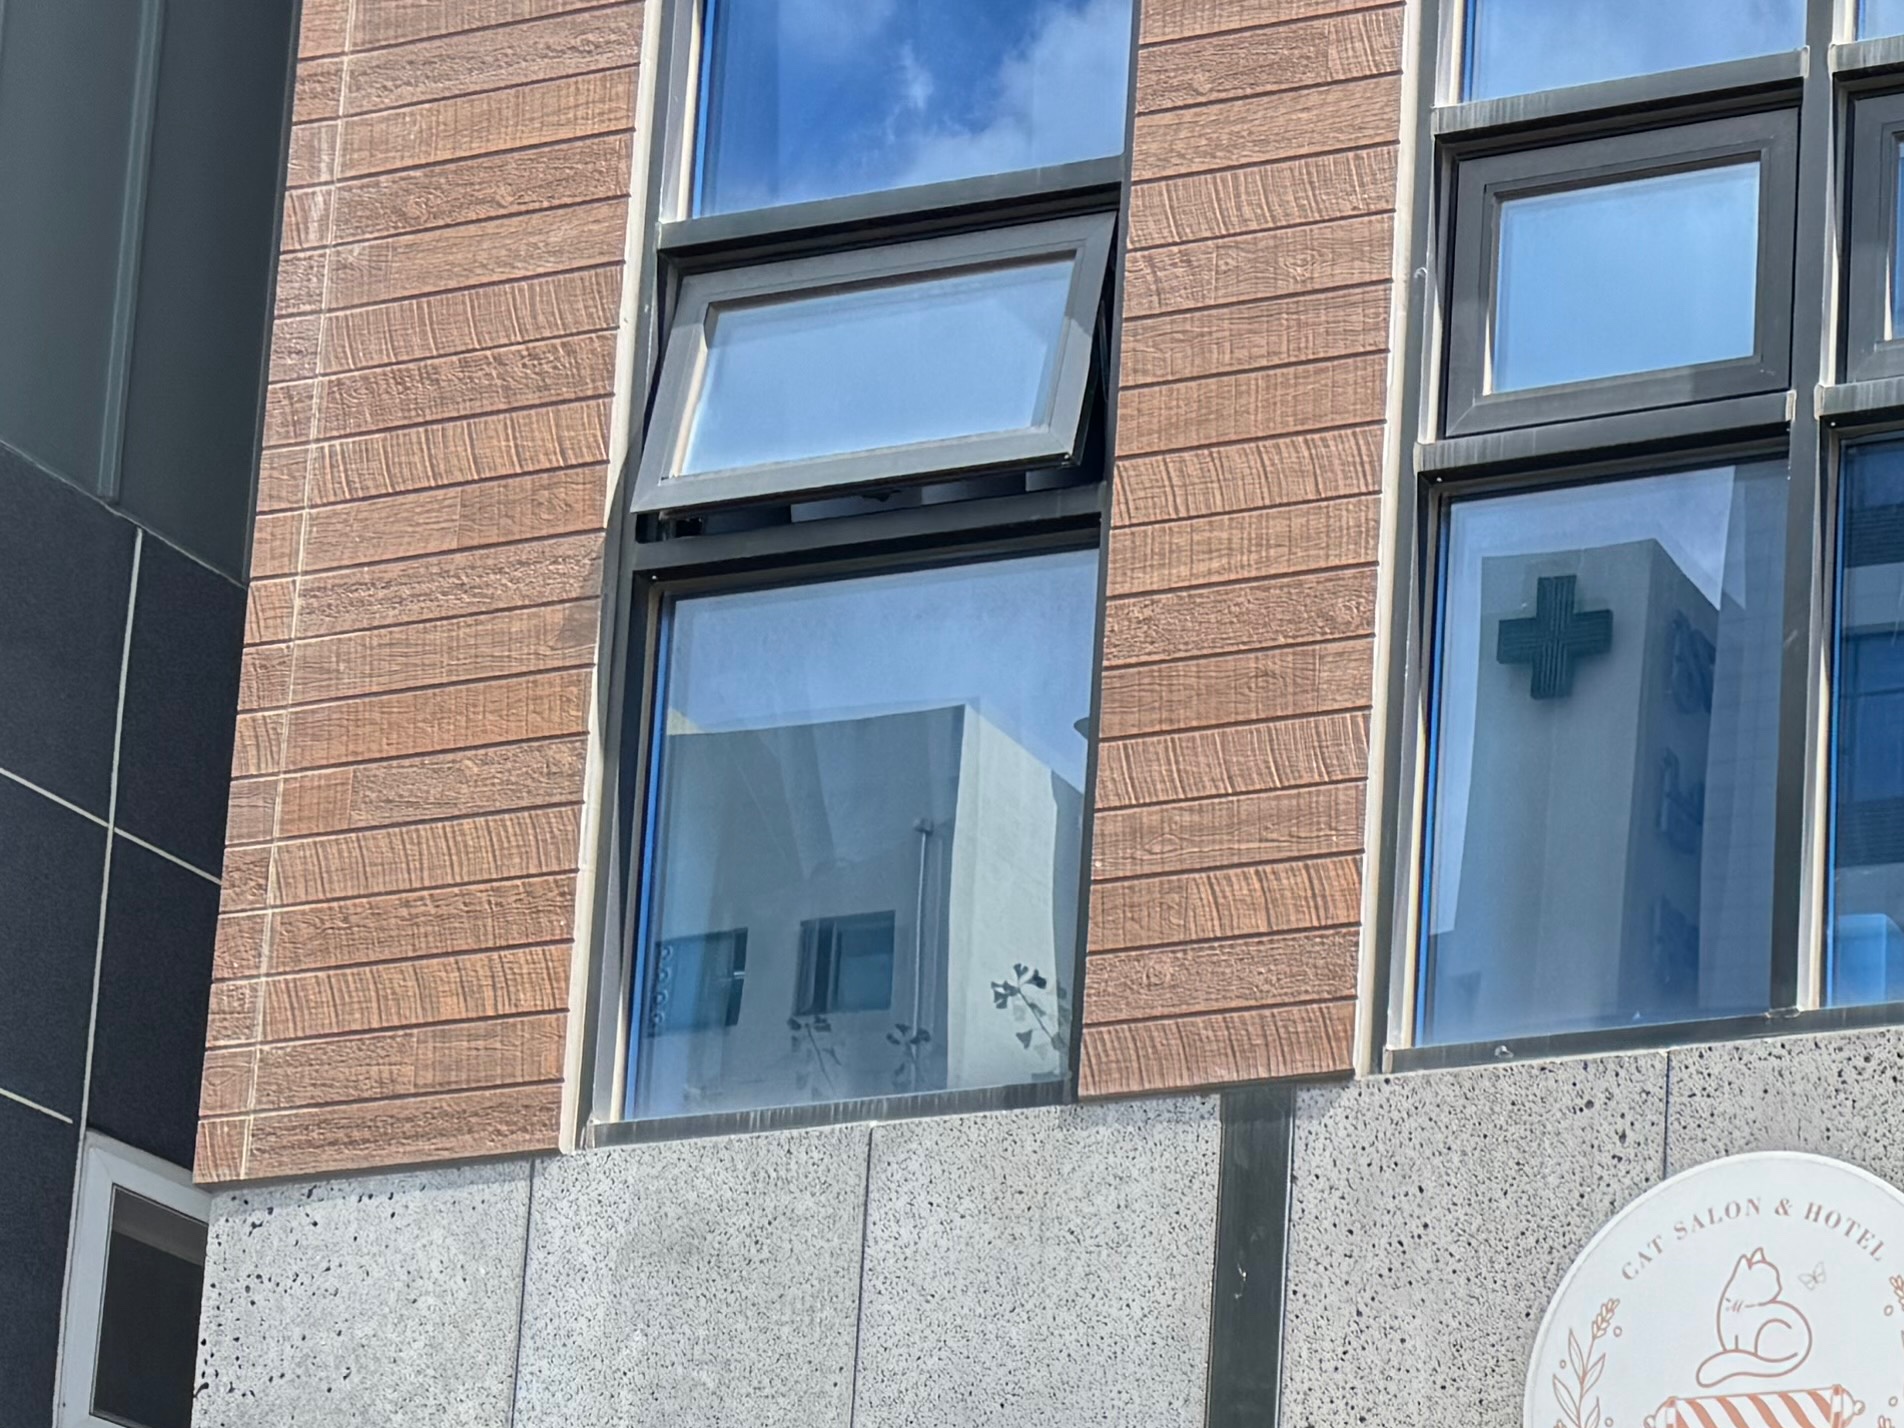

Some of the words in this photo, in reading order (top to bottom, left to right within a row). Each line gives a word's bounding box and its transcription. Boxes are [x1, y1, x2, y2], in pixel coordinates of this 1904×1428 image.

[1621, 1236, 1664, 1281] CAT
[1673, 1197, 1762, 1240] SALON
[1774, 1198, 1793, 1217] &
[1804, 1201, 1887, 1263] HOTEL
